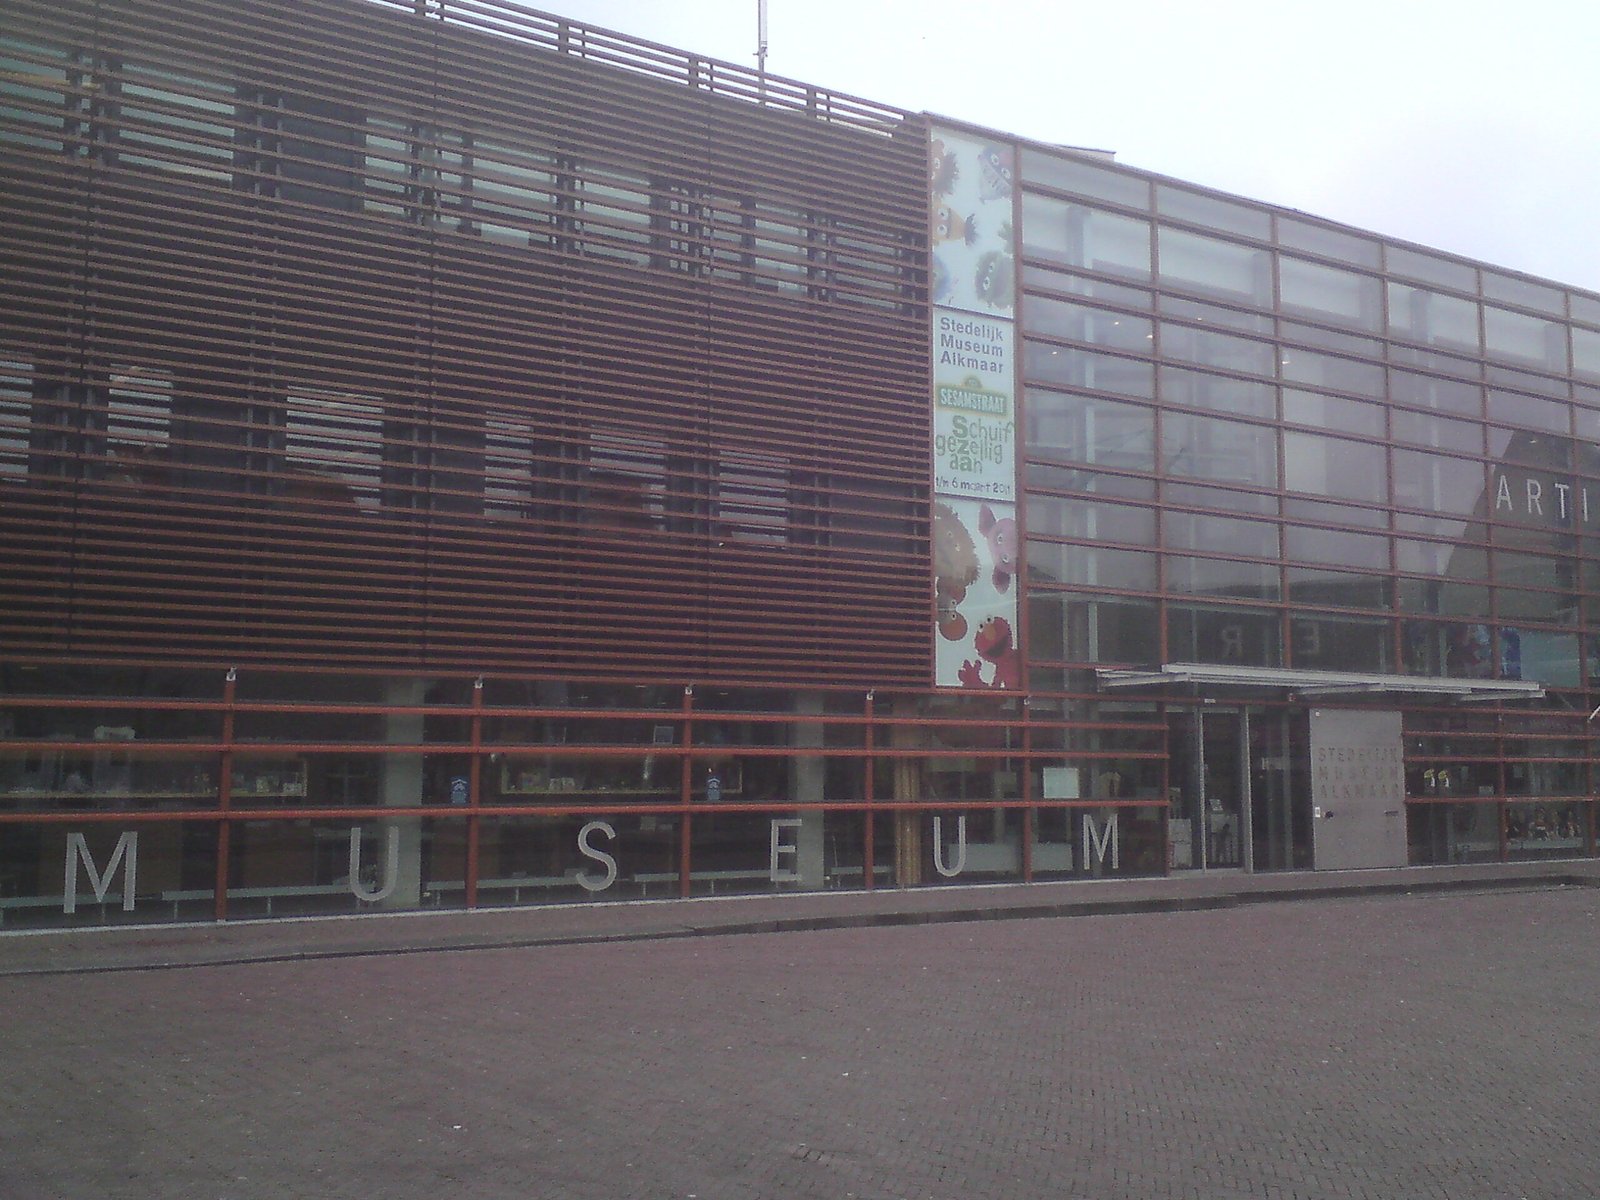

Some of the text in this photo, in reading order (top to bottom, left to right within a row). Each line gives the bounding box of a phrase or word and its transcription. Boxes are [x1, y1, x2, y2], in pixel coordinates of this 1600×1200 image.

[940, 316, 1004, 342] Stedelijk
[940, 333, 1004, 358] Museum
[940, 350, 1004, 373] Alkmaar
[952, 415, 1014, 443] Schuif
[936, 434, 1003, 464] gezellig
[949, 453, 983, 475] aan
[951, 476, 959, 489] 6
[960, 480, 991, 493] maart
[63, 813, 1120, 914] MUSEUM
